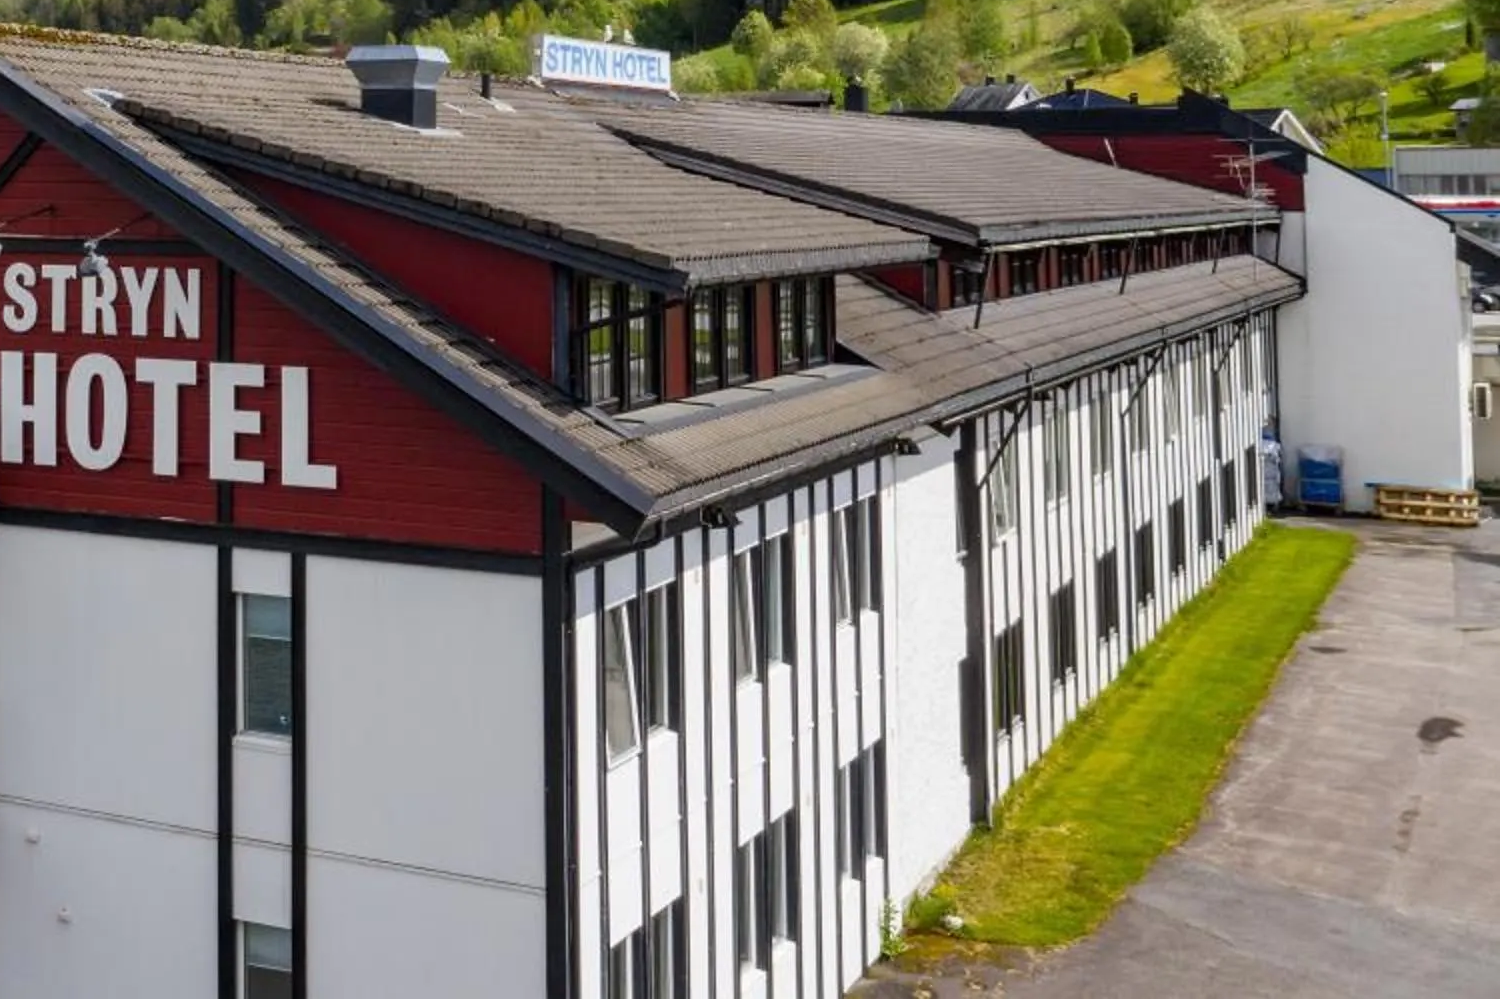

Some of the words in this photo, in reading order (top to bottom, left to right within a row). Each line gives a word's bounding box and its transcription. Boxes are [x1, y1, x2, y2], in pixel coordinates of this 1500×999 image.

[546, 43, 606, 77] STRYN
[613, 52, 667, 83] HOTEL
[3, 262, 200, 339] STRYN
[2, 351, 337, 489] HOTEL
